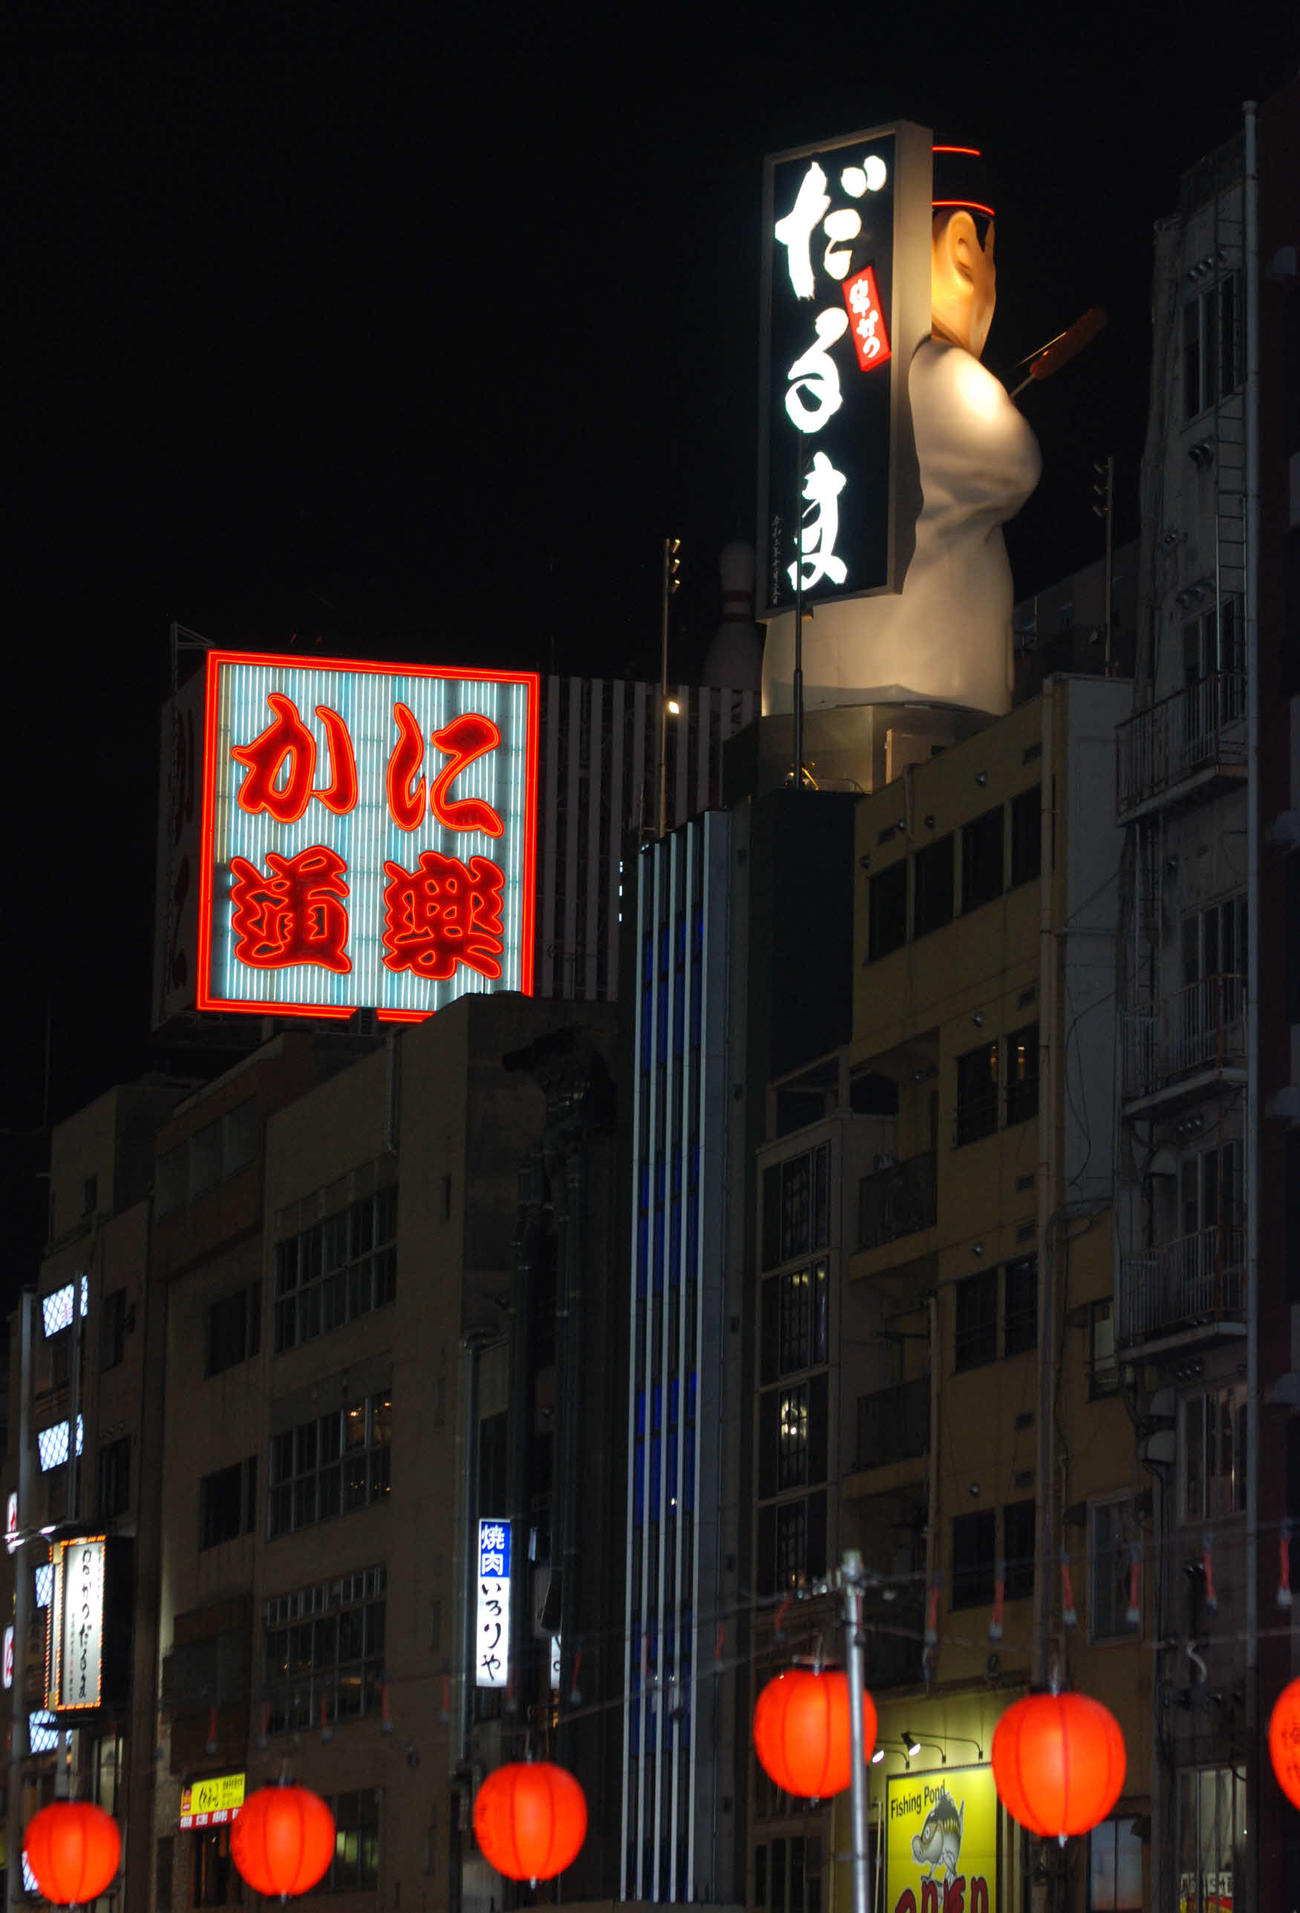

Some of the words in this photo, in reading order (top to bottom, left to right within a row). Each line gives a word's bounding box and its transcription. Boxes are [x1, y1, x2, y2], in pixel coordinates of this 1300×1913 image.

[849, 278, 881, 359] 串かつ
[774, 155, 887, 591] だるま
[229, 692, 505, 839] かに
[481, 1523, 505, 1576] 焼肉
[480, 1583, 502, 1681] いろりや
[890, 1792, 922, 1820] Fishing
